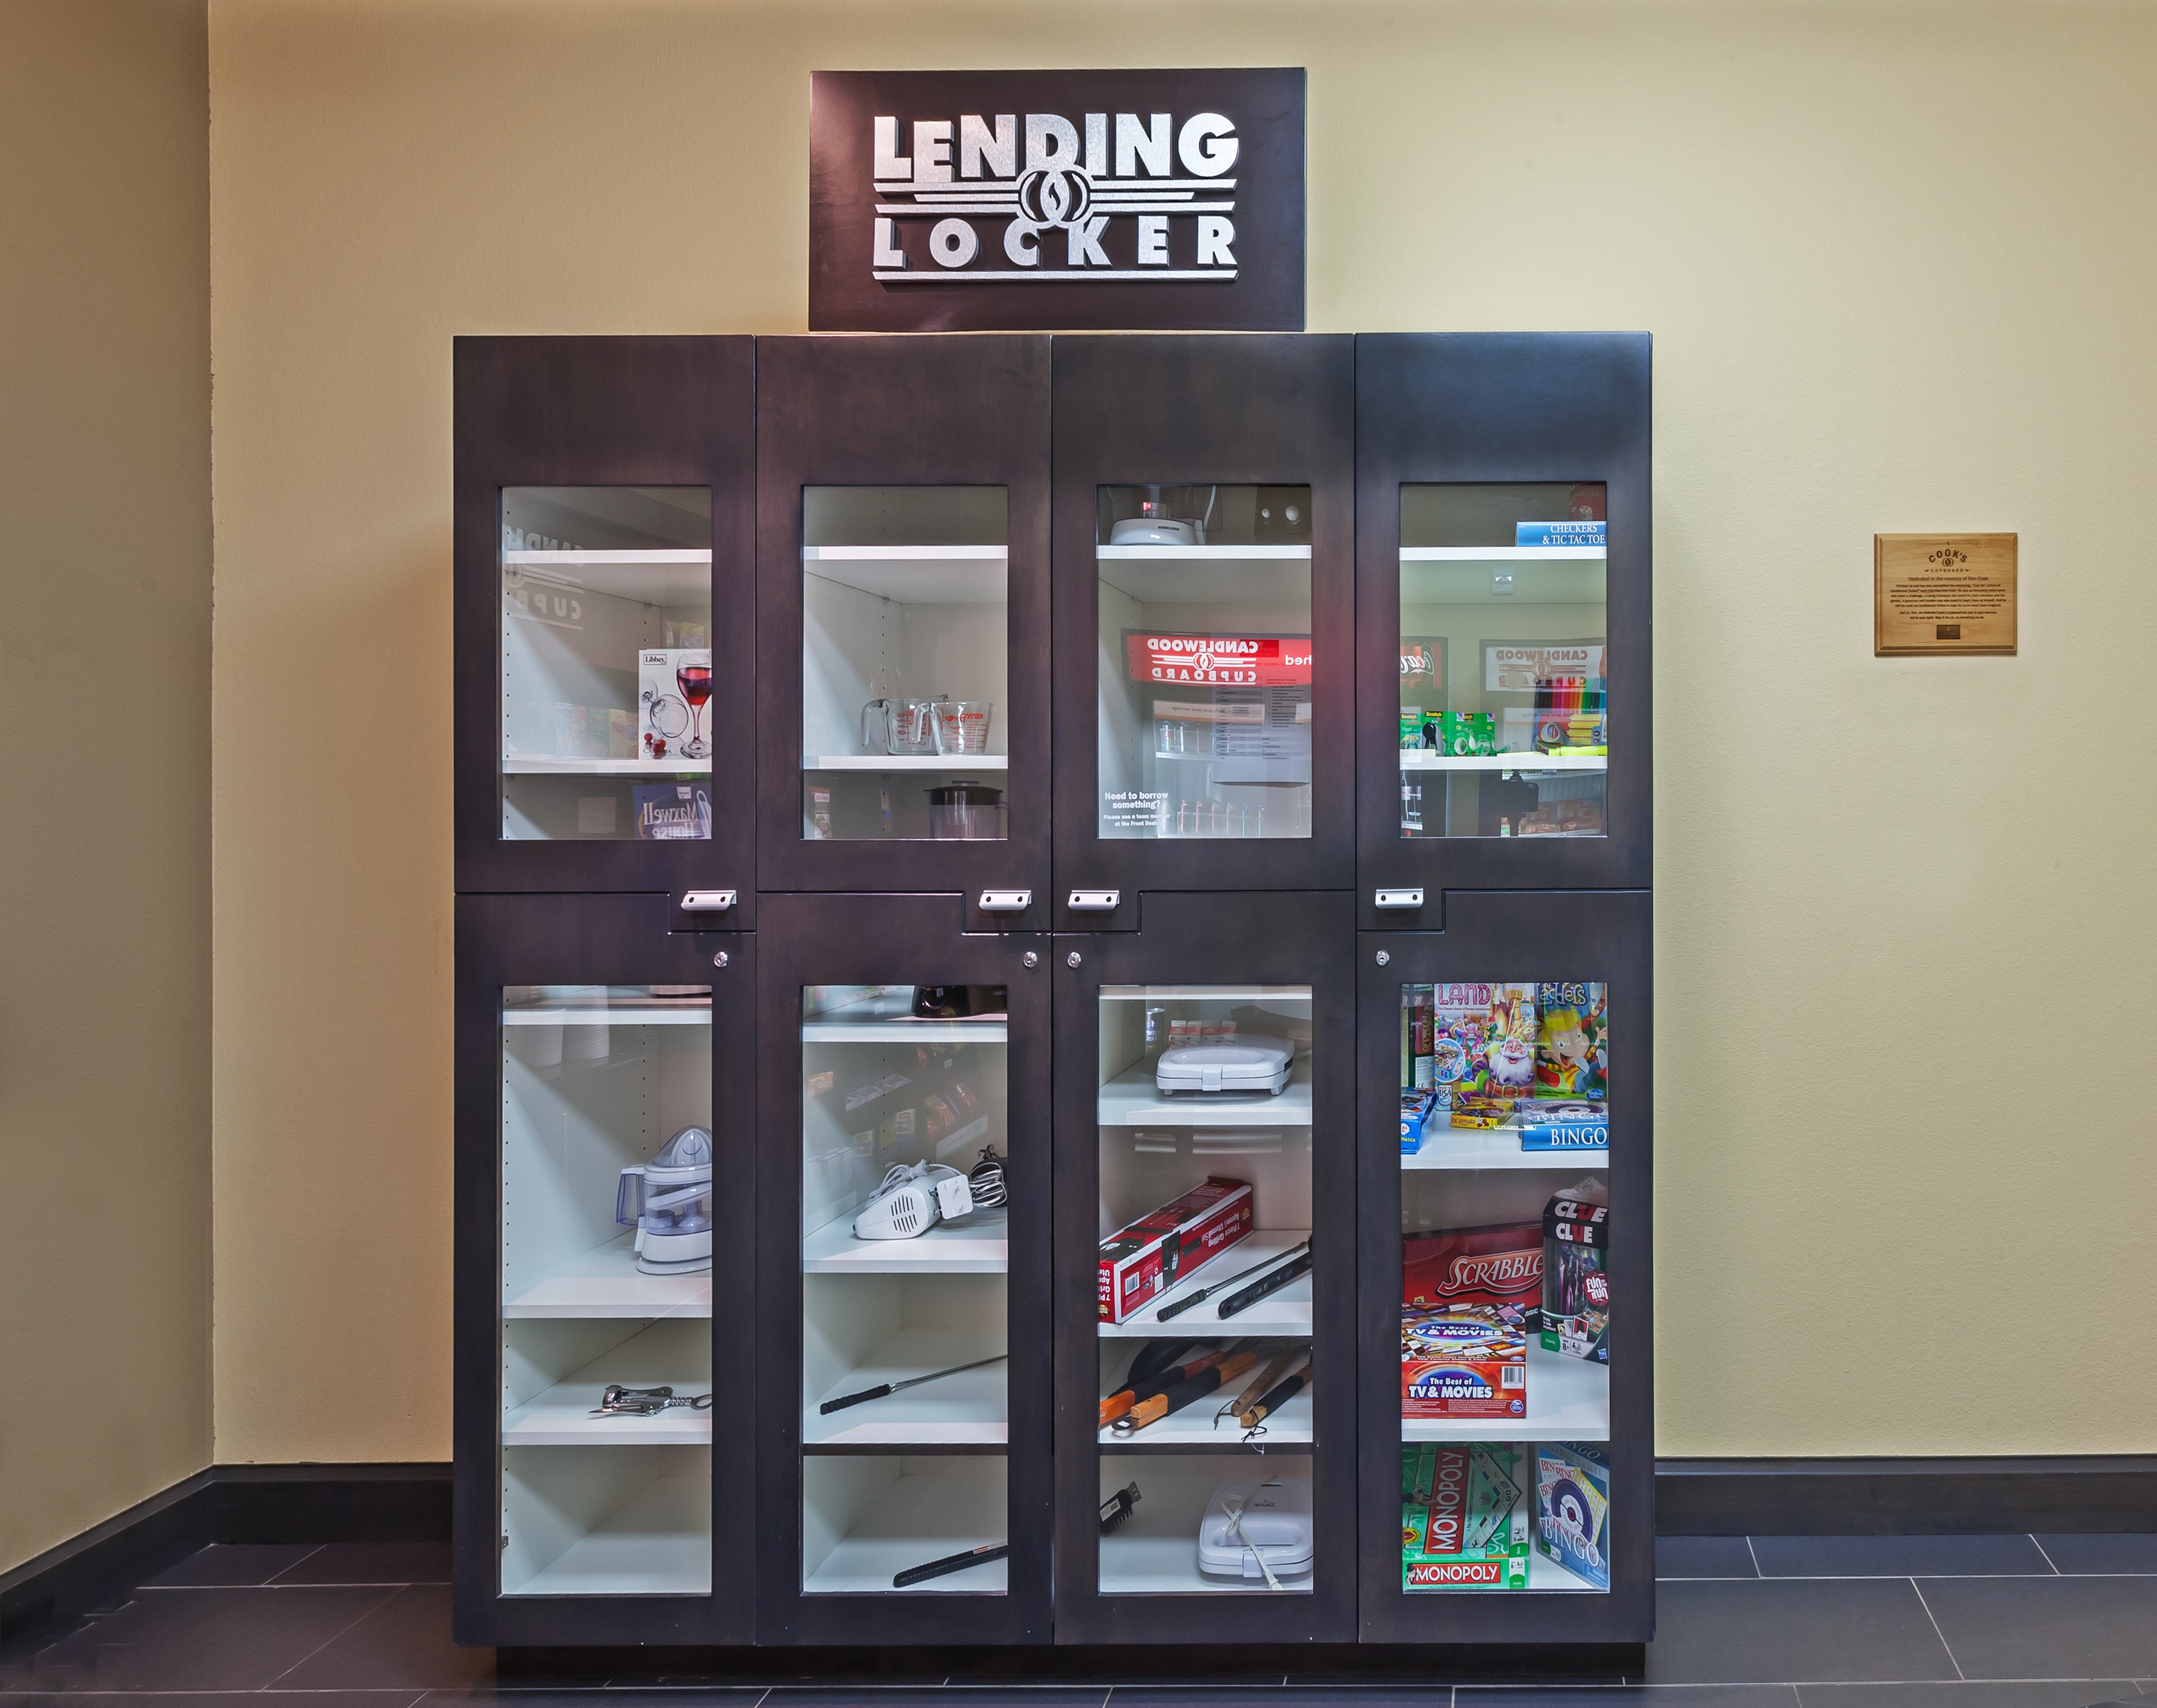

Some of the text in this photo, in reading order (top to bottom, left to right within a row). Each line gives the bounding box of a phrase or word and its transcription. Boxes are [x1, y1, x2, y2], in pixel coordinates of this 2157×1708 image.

[874, 112, 1239, 183] LENDING
[873, 215, 1238, 268] LOCKER
[1550, 523, 1597, 533] CHECKERS
[1542, 535, 1605, 544] & TIC TAC TOE
[1929, 549, 1967, 563] COOK'S
[1112, 800, 1161, 809] something?
[1438, 984, 1491, 1005] LAND
[1439, 1089, 1451, 1097] USA
[1551, 1127, 1608, 1146] BINGO
[1555, 1201, 1608, 1223] CLUE
[1556, 1223, 1593, 1244] CLUE
[1586, 1276, 1602, 1290] FUN
[1587, 1287, 1609, 1300] RUN
[1525, 1308, 1539, 1317] SSIC
[1409, 1386, 1492, 1398] TV & MOVIES
[1430, 1452, 1463, 1550] MONOPOLY
[1505, 1490, 1511, 1501] GO
[1544, 1516, 1599, 1566] BINGO
[1416, 1565, 1498, 1581] MONOPOLY
